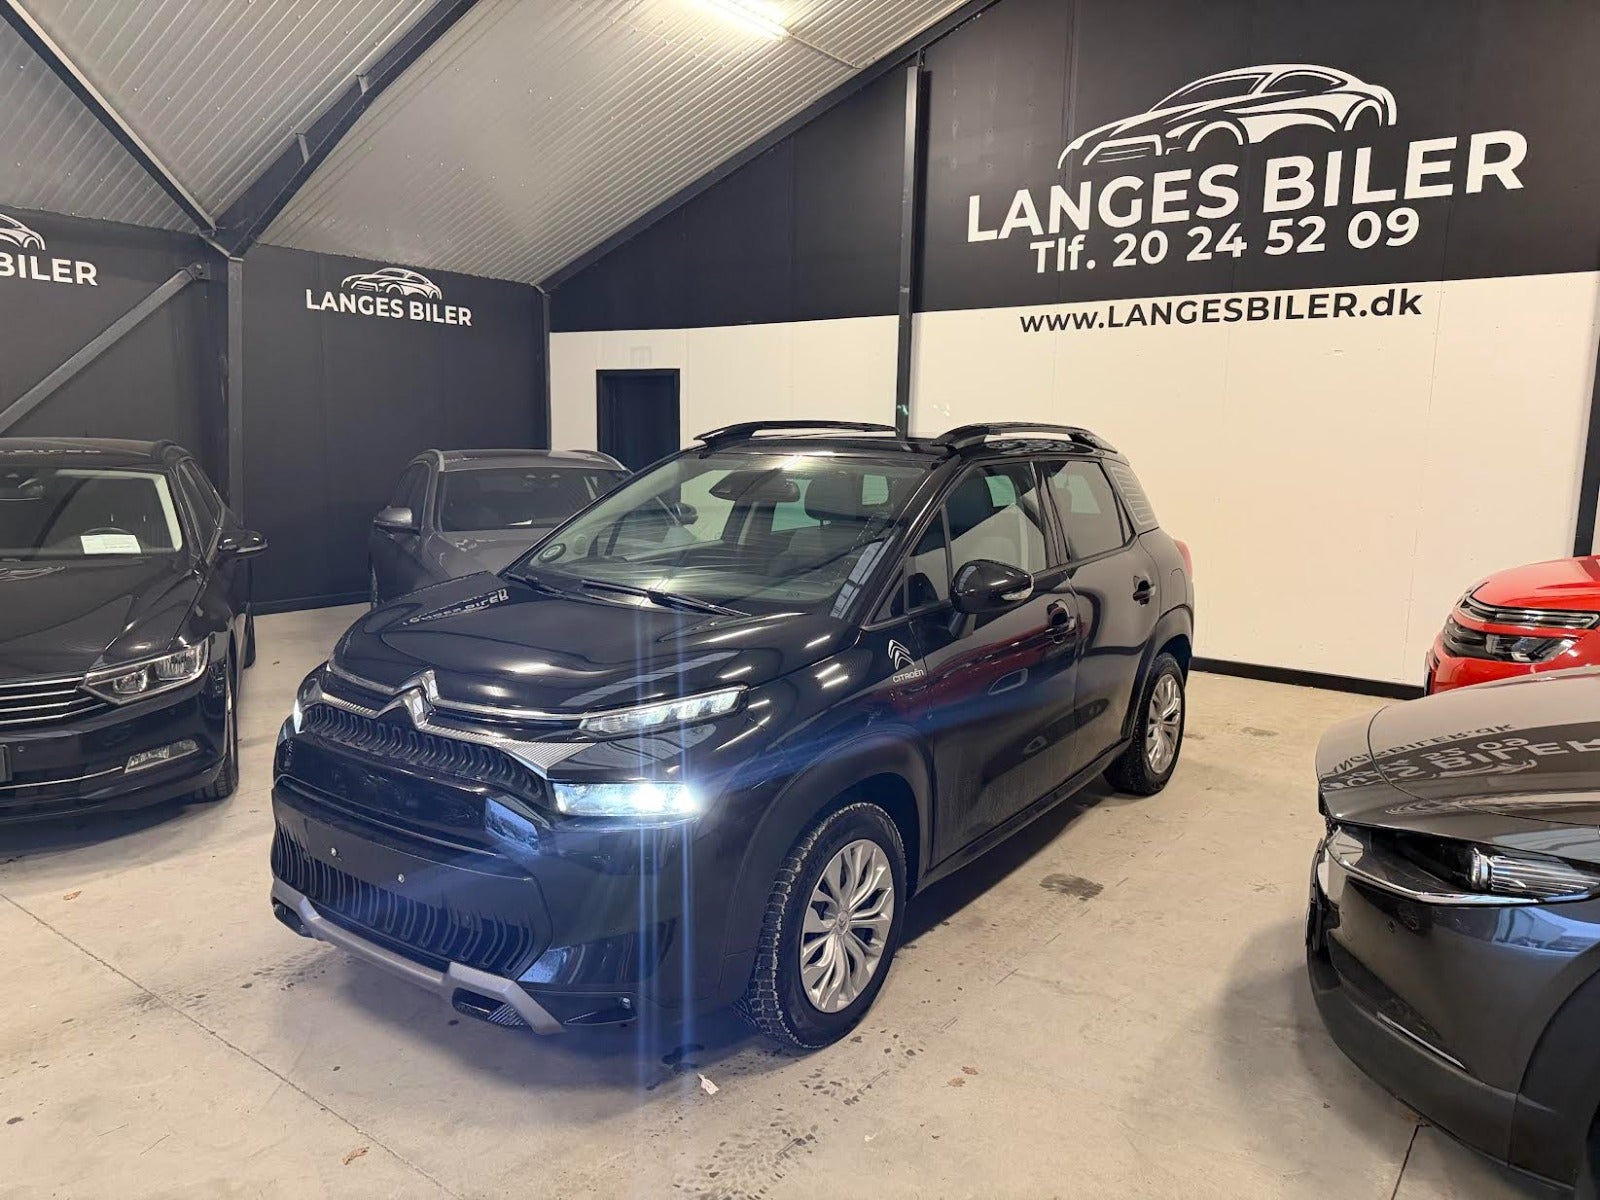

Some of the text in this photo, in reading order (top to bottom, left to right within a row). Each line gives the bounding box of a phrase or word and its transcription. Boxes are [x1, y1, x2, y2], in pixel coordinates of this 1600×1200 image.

[967, 130, 1528, 243] LANGES BILER
[1029, 207, 1420, 273] Tlf. 20 24 52 09
[0, 251, 98, 286] BILER
[305, 288, 472, 326] LANGES BILER
[1019, 288, 1423, 333] www.LANGESBILER.dk
